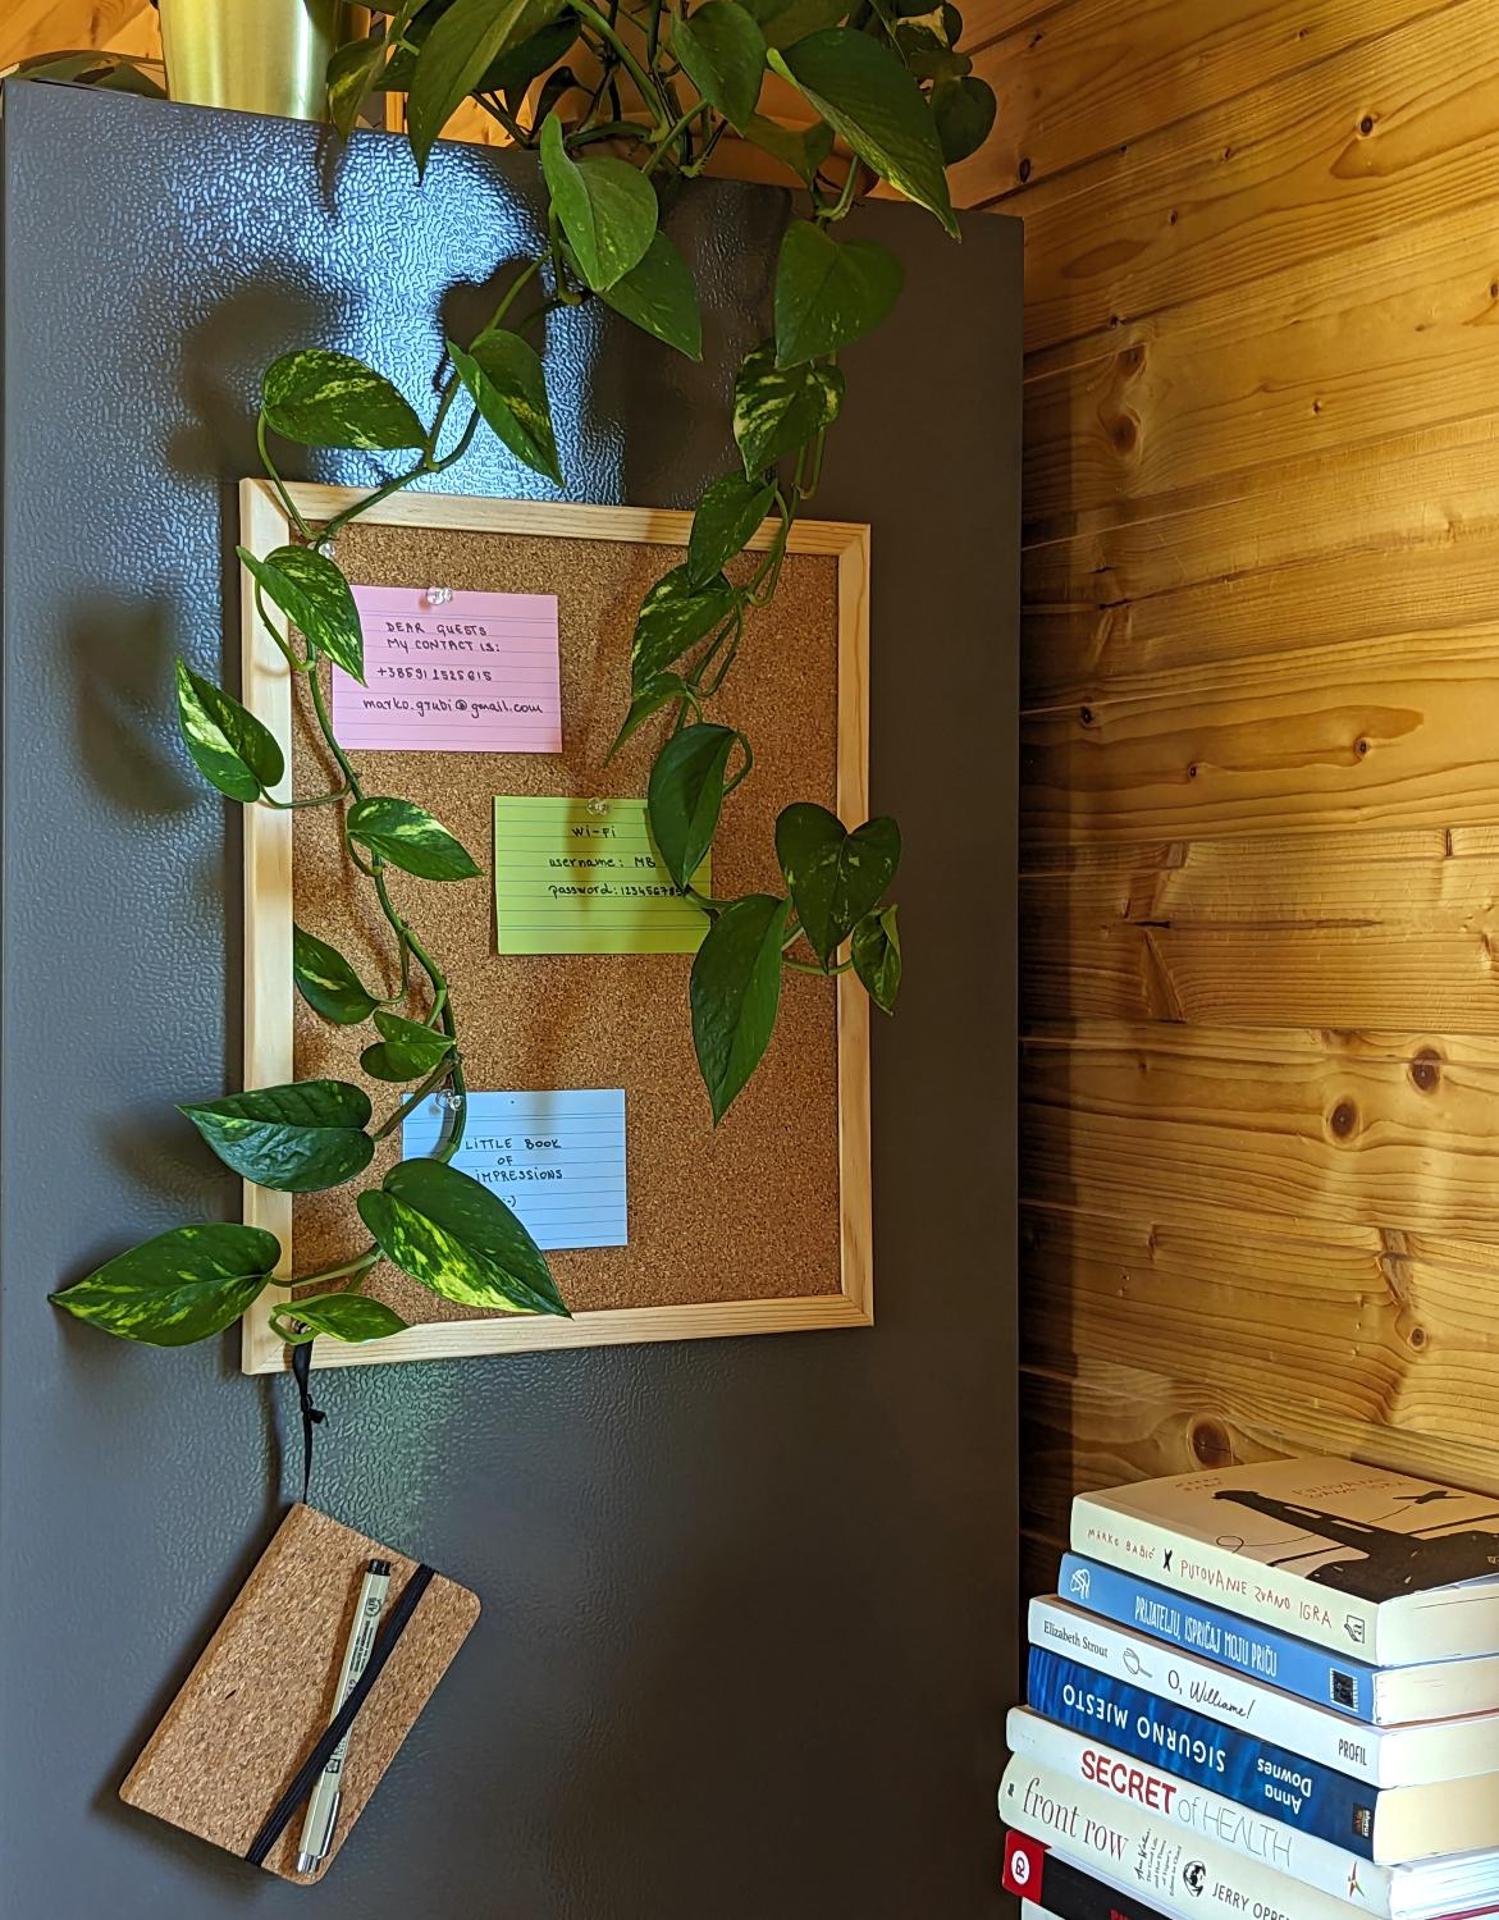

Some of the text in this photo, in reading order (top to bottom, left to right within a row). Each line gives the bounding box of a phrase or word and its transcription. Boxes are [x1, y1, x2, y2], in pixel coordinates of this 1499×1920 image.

[386, 622, 487, 637] DEAR GUESTS
[415, 639, 473, 652] CONTACT
[549, 857, 656, 868] username: MB
[497, 1155, 513, 1166] OF
[524, 1138, 562, 1150] BOOK
[1255, 1586, 1291, 1610] ZVANO
[1299, 1600, 1332, 1628] IGRA
[1134, 1595, 1277, 1678] PRIJATELJU, ISPRIČAJ MOJU PRIČU
[1044, 1620, 1080, 1646] Elizabeth
[1082, 1635, 1109, 1659] Strout
[1168, 1669, 1183, 1695] O,
[1338, 1738, 1367, 1766] PROFIL
[1063, 1684, 1226, 1773] SIGURNO MJESTO
[1257, 1758, 1312, 1798] Downes
[1081, 1750, 1177, 1814] SECRET
[1178, 1796, 1199, 1826] of
[1203, 1802, 1293, 1868] HEALTH
[1264, 1783, 1302, 1815] Anna
[1023, 1777, 1080, 1838] front
[1084, 1818, 1129, 1861] row
[1212, 1882, 1250, 1911] JERRY
